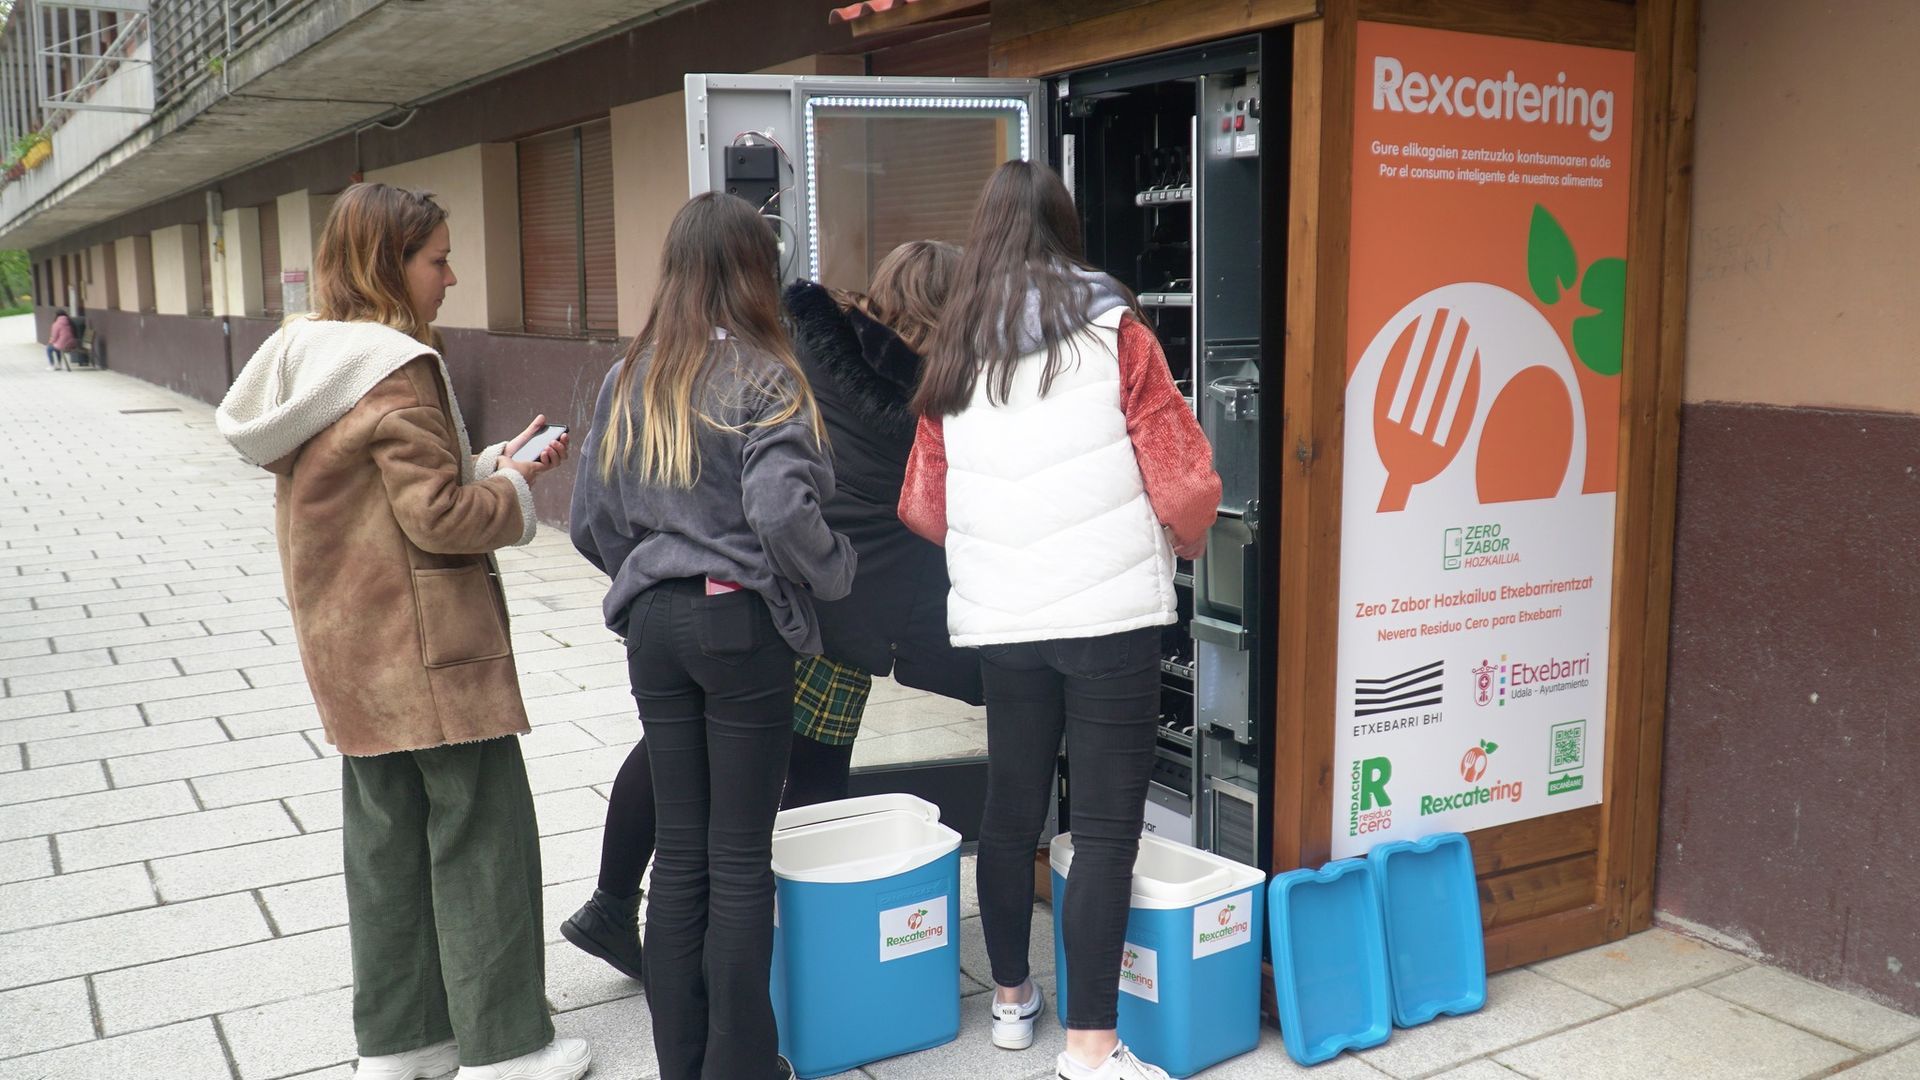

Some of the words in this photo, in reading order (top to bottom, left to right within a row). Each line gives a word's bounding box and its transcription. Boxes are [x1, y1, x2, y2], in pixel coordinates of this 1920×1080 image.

[1373, 55, 1614, 141] Rexcatering
[1371, 140, 1400, 156] Gure
[1402, 143, 1459, 161] elikagaien
[1461, 148, 1515, 163] zentzuzko
[1517, 149, 1588, 168] kontsumoaren
[1590, 155, 1612, 168] alde
[1379, 163, 1397, 177] Por
[1399, 164, 1409, 177] el
[1410, 167, 1455, 180] consumo
[1457, 168, 1506, 185] inteligente
[1508, 170, 1520, 183] de
[1522, 172, 1560, 185] nuestros
[1561, 173, 1603, 188] alimentos
[1465, 523, 1502, 540] ZERO
[1464, 537, 1510, 555] ZABOR
[1464, 552, 1521, 568] HOZKAILUA
[1355, 602, 1387, 619] Zero
[1391, 596, 1431, 614] Zabor
[1434, 587, 1497, 609] Hozkailua
[1500, 575, 1593, 600] Etxebarrirentzat
[1377, 627, 1418, 642] Nevera
[1420, 620, 1462, 637] Residuo
[1465, 617, 1489, 631] Cero
[1492, 614, 1516, 630] para
[1518, 605, 1562, 623] Etxebarri
[1511, 652, 1590, 686] Etxebarri
[1511, 687, 1533, 700] Udala
[1539, 678, 1590, 696] Ayuntamiento
[1353, 716, 1419, 737] ETXEBARRI
[1423, 712, 1443, 726] BHI
[1360, 756, 1392, 811] R
[1350, 760, 1361, 837] FUNDACIÓN
[1420, 779, 1523, 817] Rexcatering
[1359, 809, 1392, 823] residuo
[1359, 817, 1392, 834] cero
[886, 925, 943, 948] Rexcatering
[1199, 921, 1248, 944] Rexcatering
[1119, 968, 1153, 990] catering
